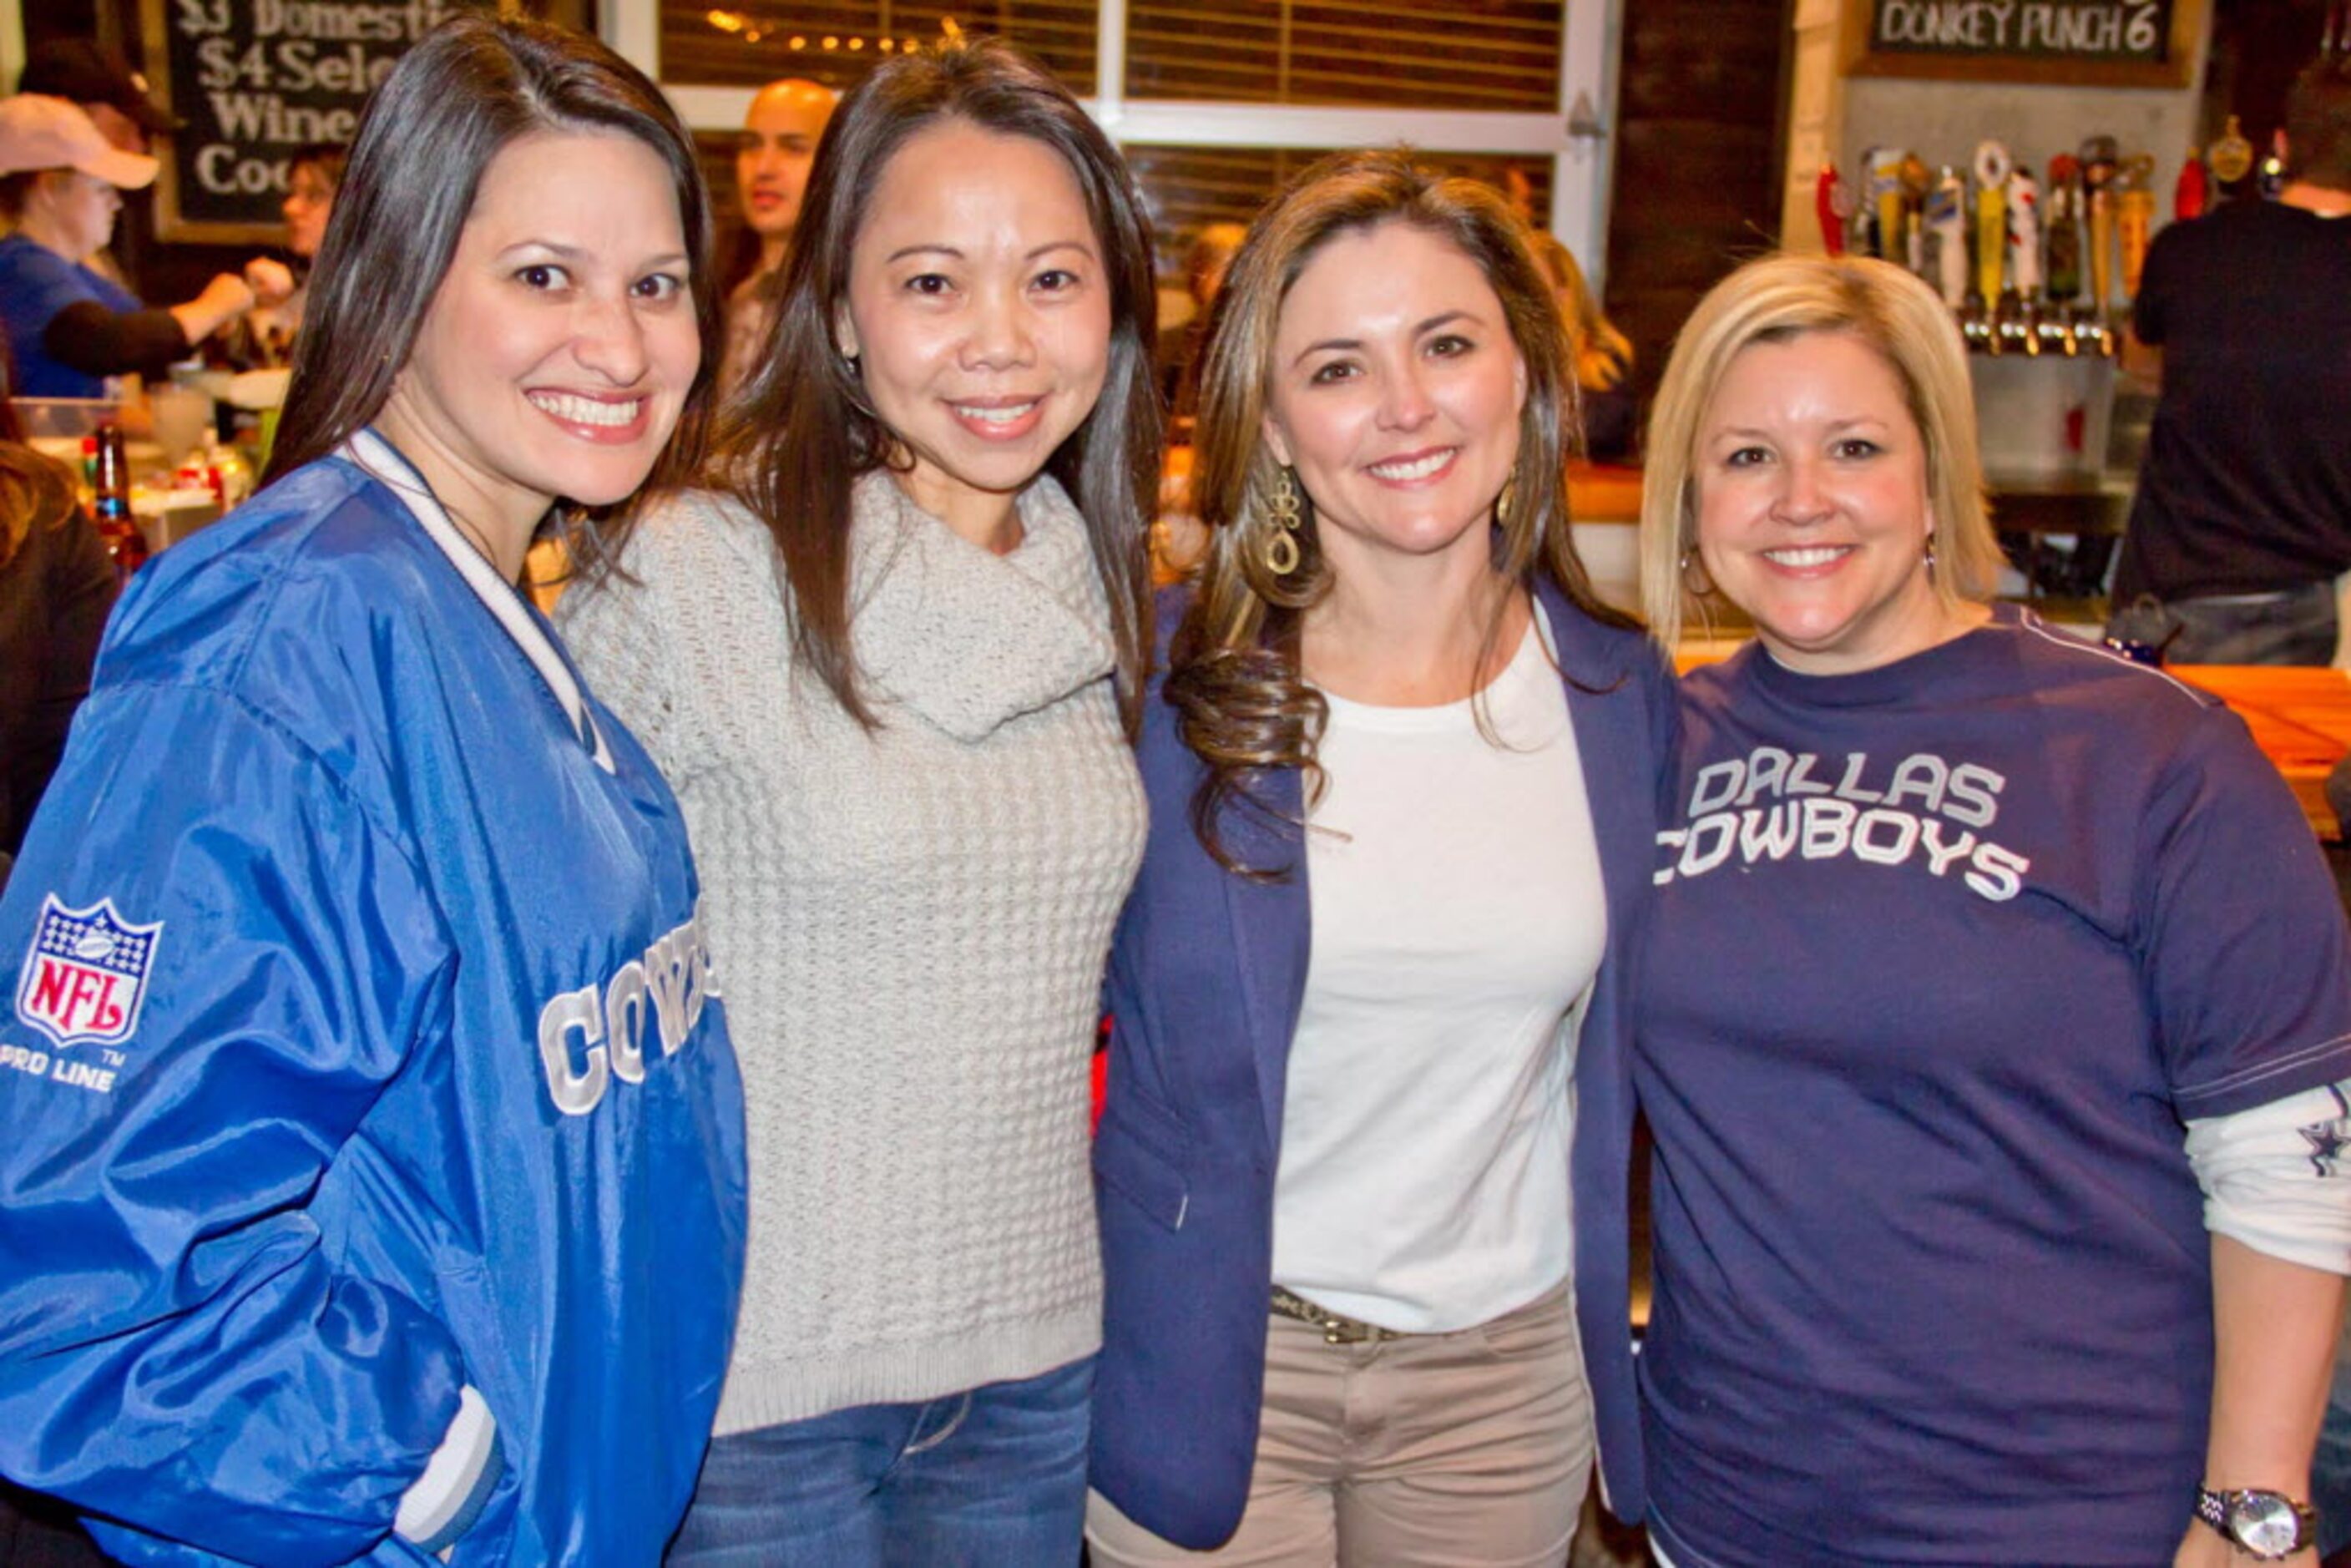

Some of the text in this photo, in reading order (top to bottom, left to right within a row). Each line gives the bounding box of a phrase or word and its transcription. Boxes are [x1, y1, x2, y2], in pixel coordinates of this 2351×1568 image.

[254, 0, 459, 42] Domesti
[1880, 1, 2158, 50] DONKEY PUNCH 6
[197, 38, 271, 89] $4
[1688, 746, 2005, 827] DALLAS
[32, 959, 123, 1031] NFL
[0, 1044, 115, 1093] PRO LINE
[102, 1049, 126, 1067] TM
